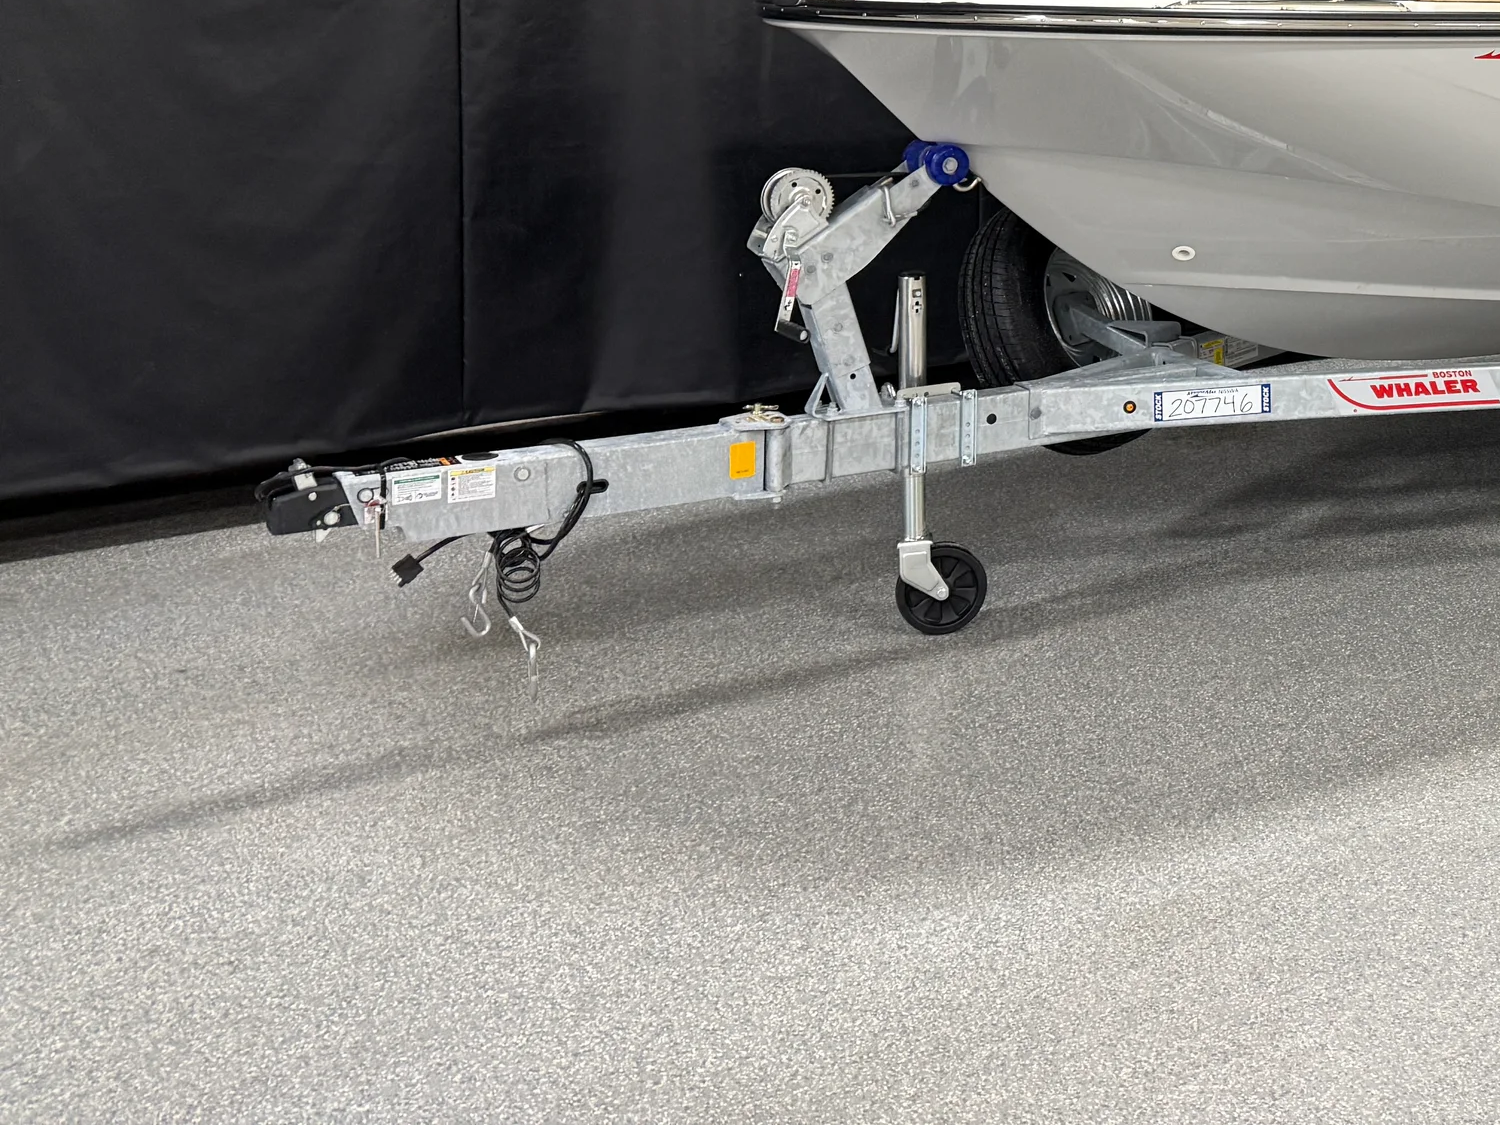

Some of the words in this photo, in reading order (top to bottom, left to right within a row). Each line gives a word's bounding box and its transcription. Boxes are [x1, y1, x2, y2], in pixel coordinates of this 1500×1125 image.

[1432, 370, 1473, 379] BOSTON
[1262, 386, 1270, 412] STOCK
[1370, 379, 1481, 399] WHALER
[1168, 393, 1253, 418] 207746
